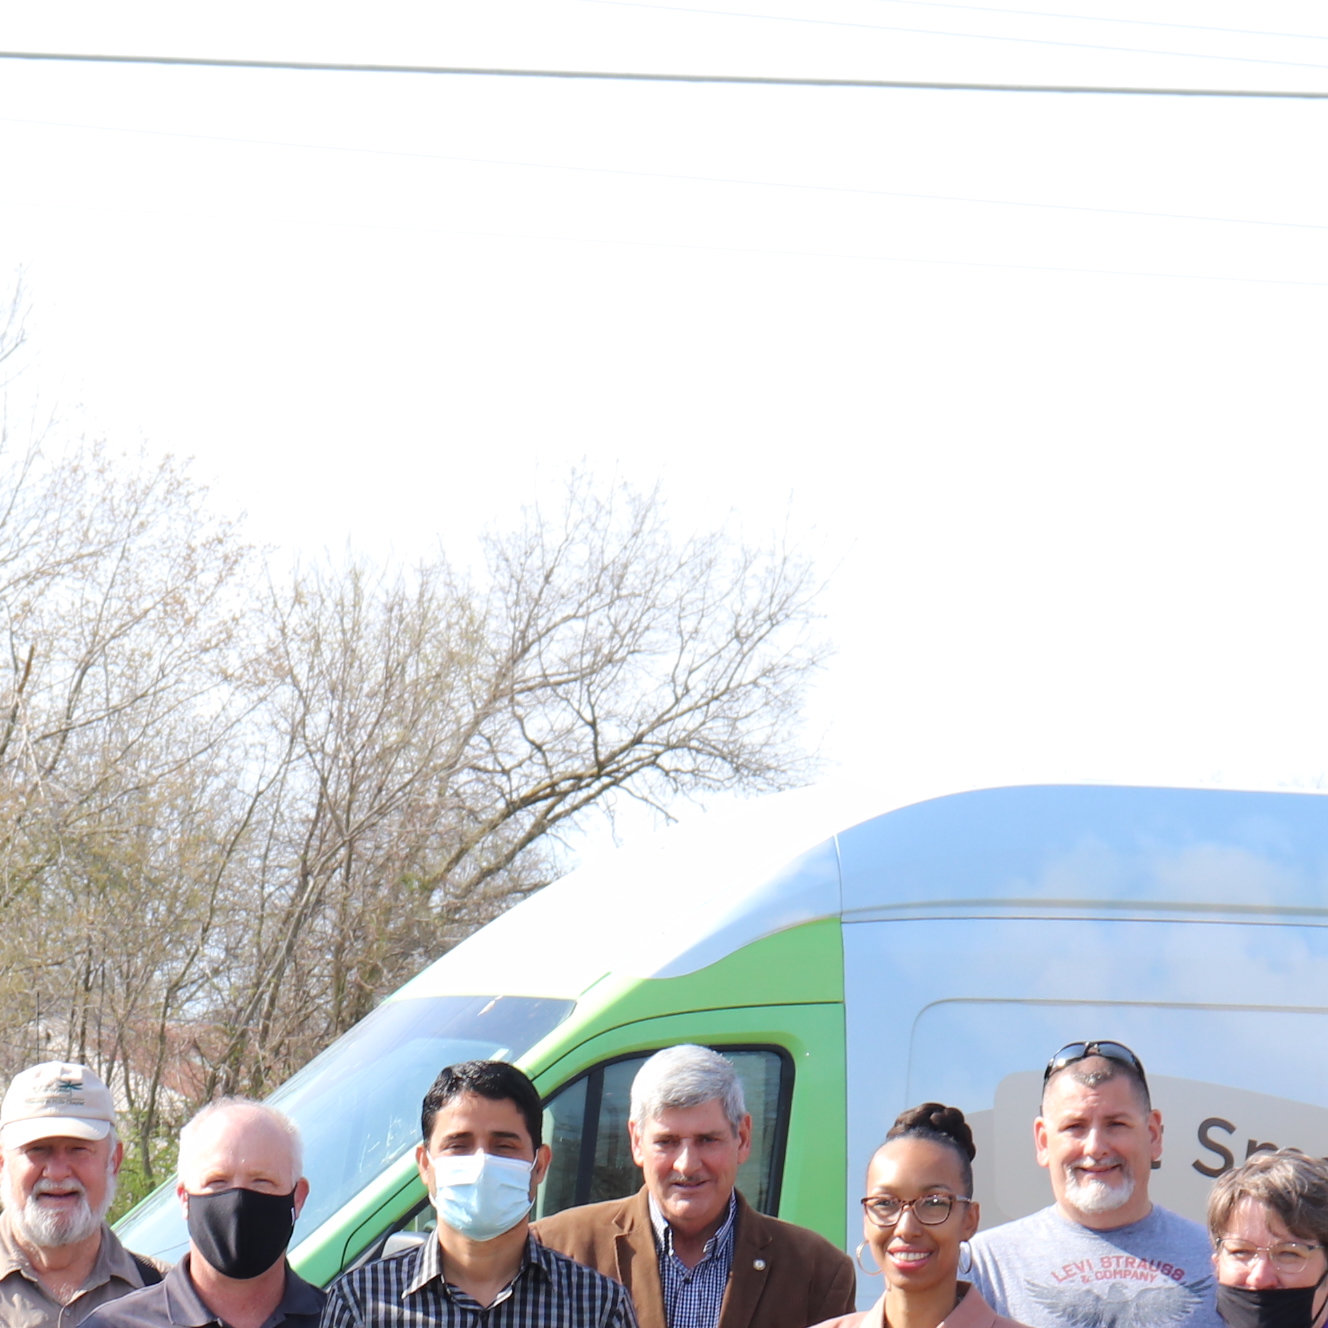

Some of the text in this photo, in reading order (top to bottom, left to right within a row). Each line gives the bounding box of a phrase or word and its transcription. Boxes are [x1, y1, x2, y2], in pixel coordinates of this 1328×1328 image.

[1051, 1255, 1185, 1283] LEVI STRAUSS
[1095, 1269, 1158, 1283] COMPANY
